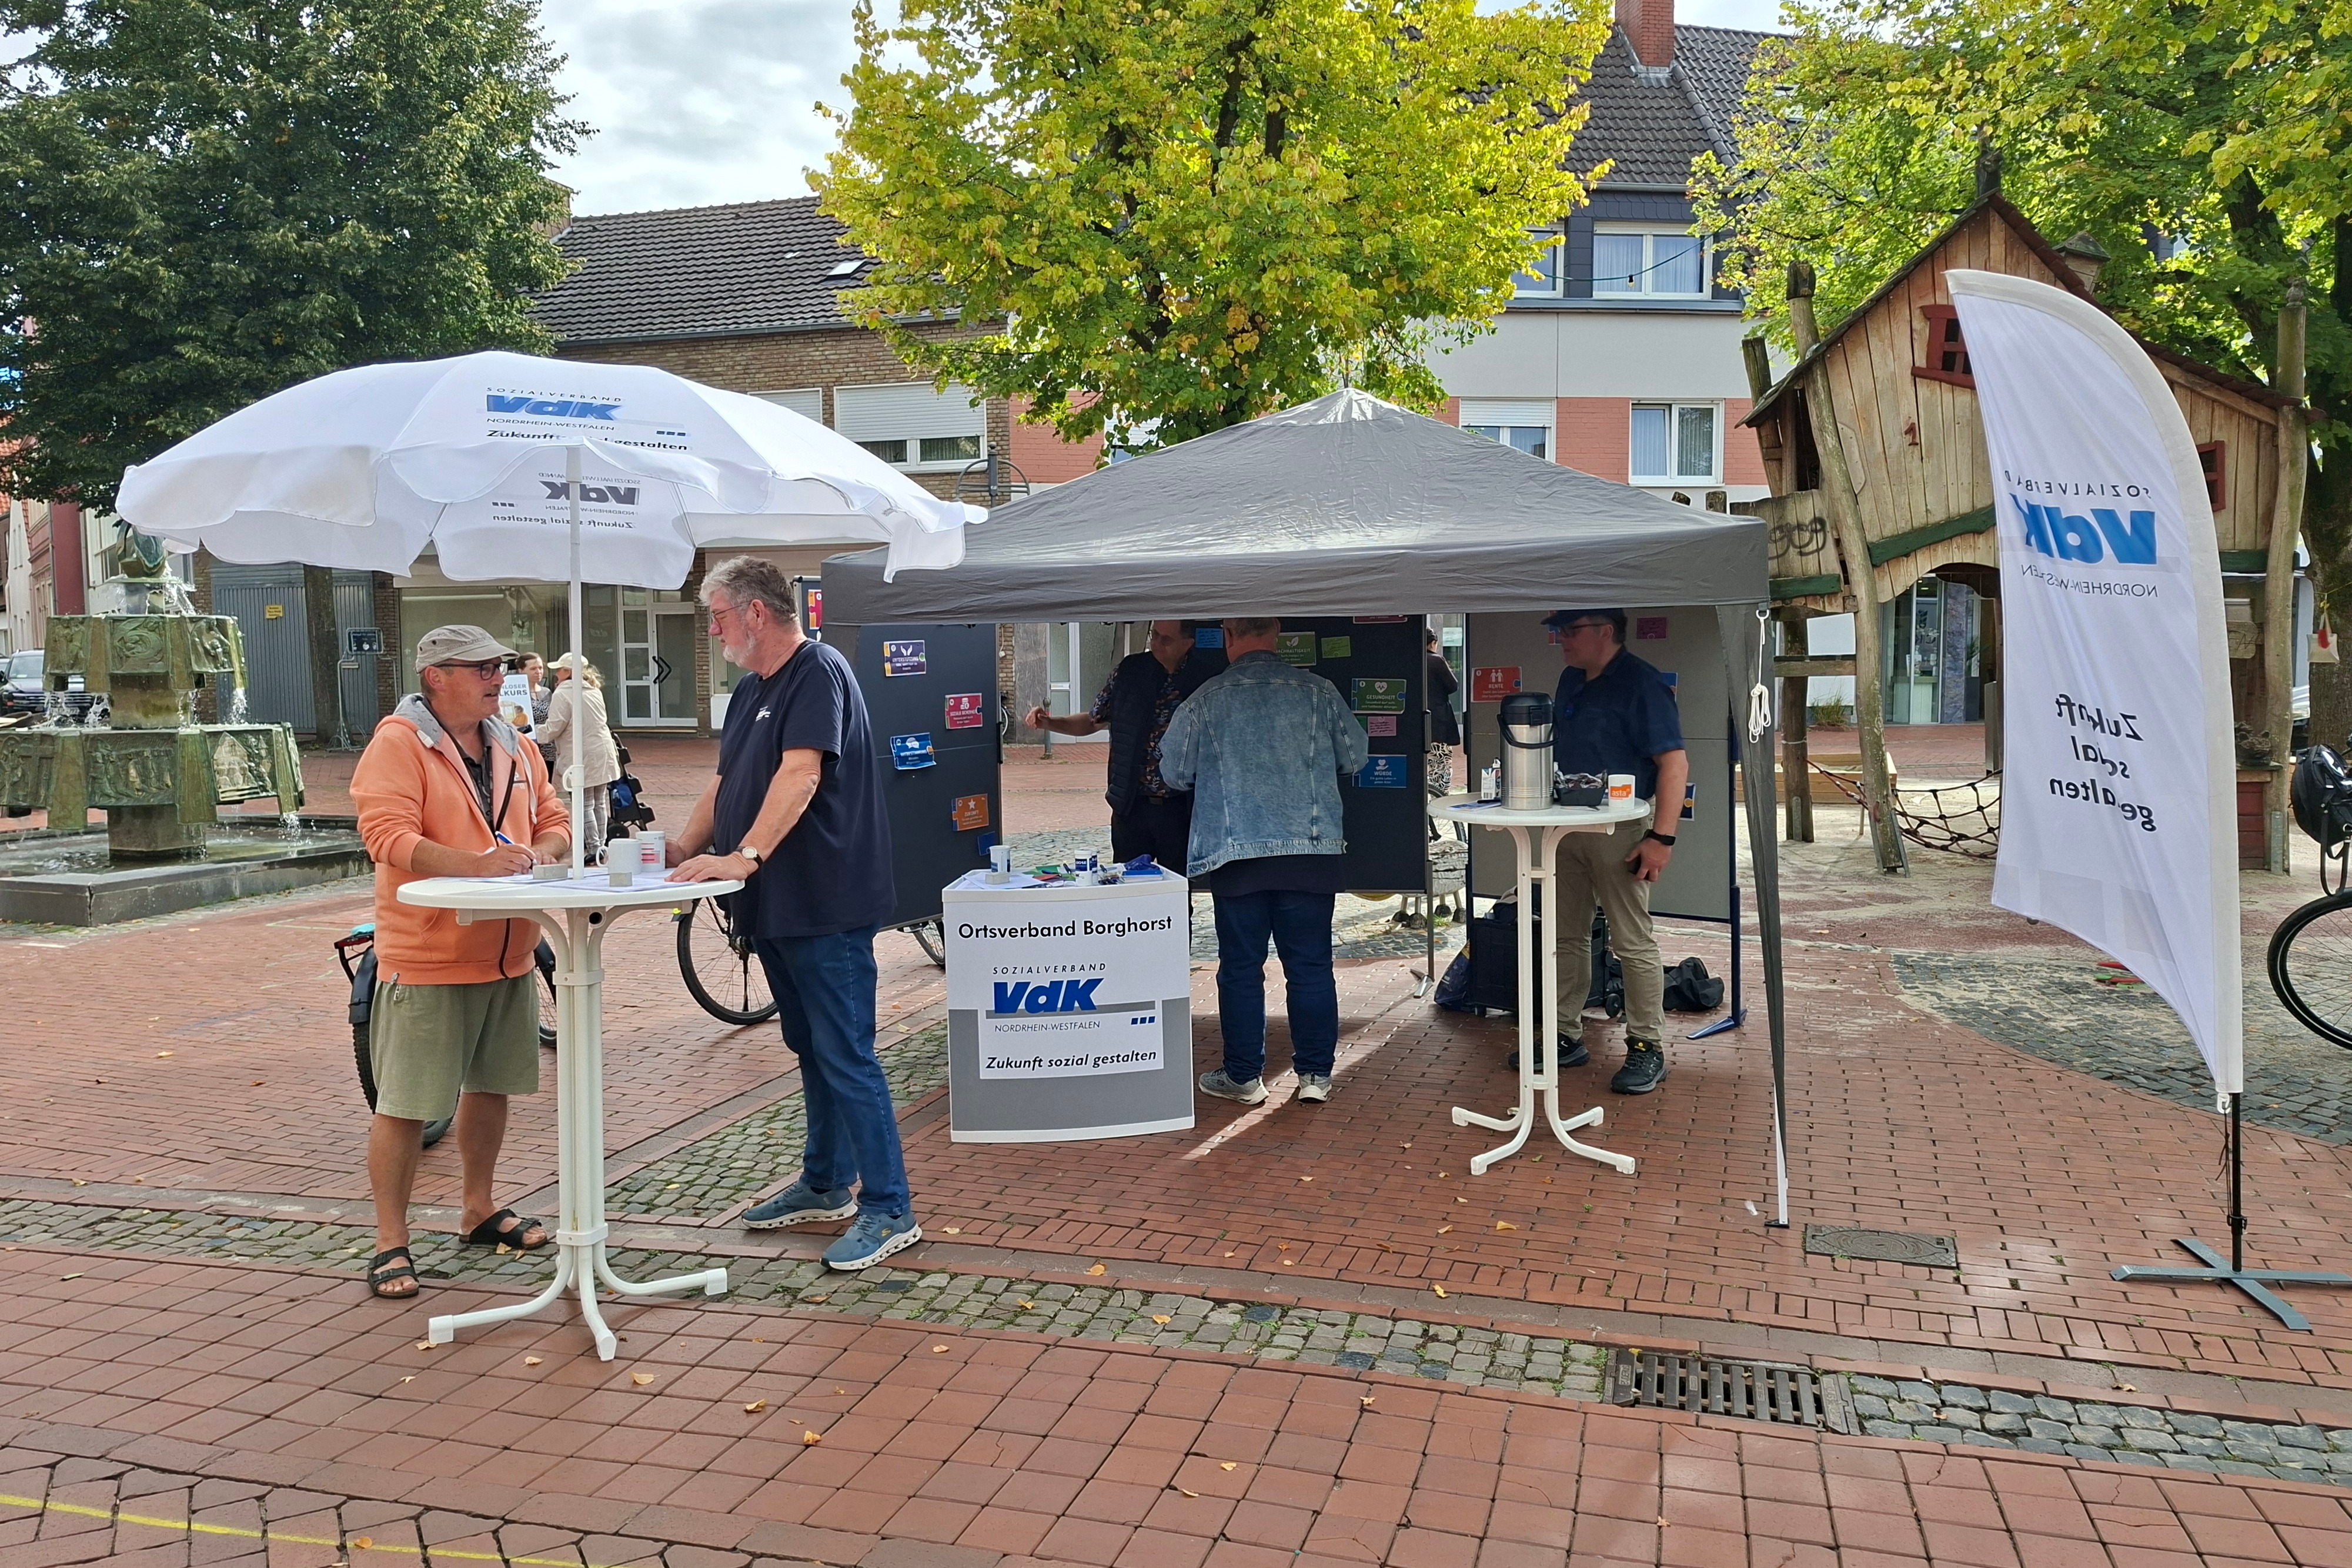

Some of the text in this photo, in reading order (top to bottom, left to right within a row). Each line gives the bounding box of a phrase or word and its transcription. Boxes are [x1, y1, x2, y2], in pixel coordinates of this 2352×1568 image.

[486, 387, 622, 402] SOZIALVERBAND
[486, 394, 622, 421] VdK
[487, 418, 614, 431] NORDRHEIN-WESTFALEN
[1905, 423, 1919, 446] 1
[958, 916, 1172, 939] Ortsverband Borghorst
[993, 963, 1106, 975] SOZIALVERBAND
[994, 978, 1104, 1014] VdK
[995, 1021, 1100, 1032] NORDRHEIN-WESTFALEN
[985, 1051, 1156, 1071] Zukunft sozial gestalten
